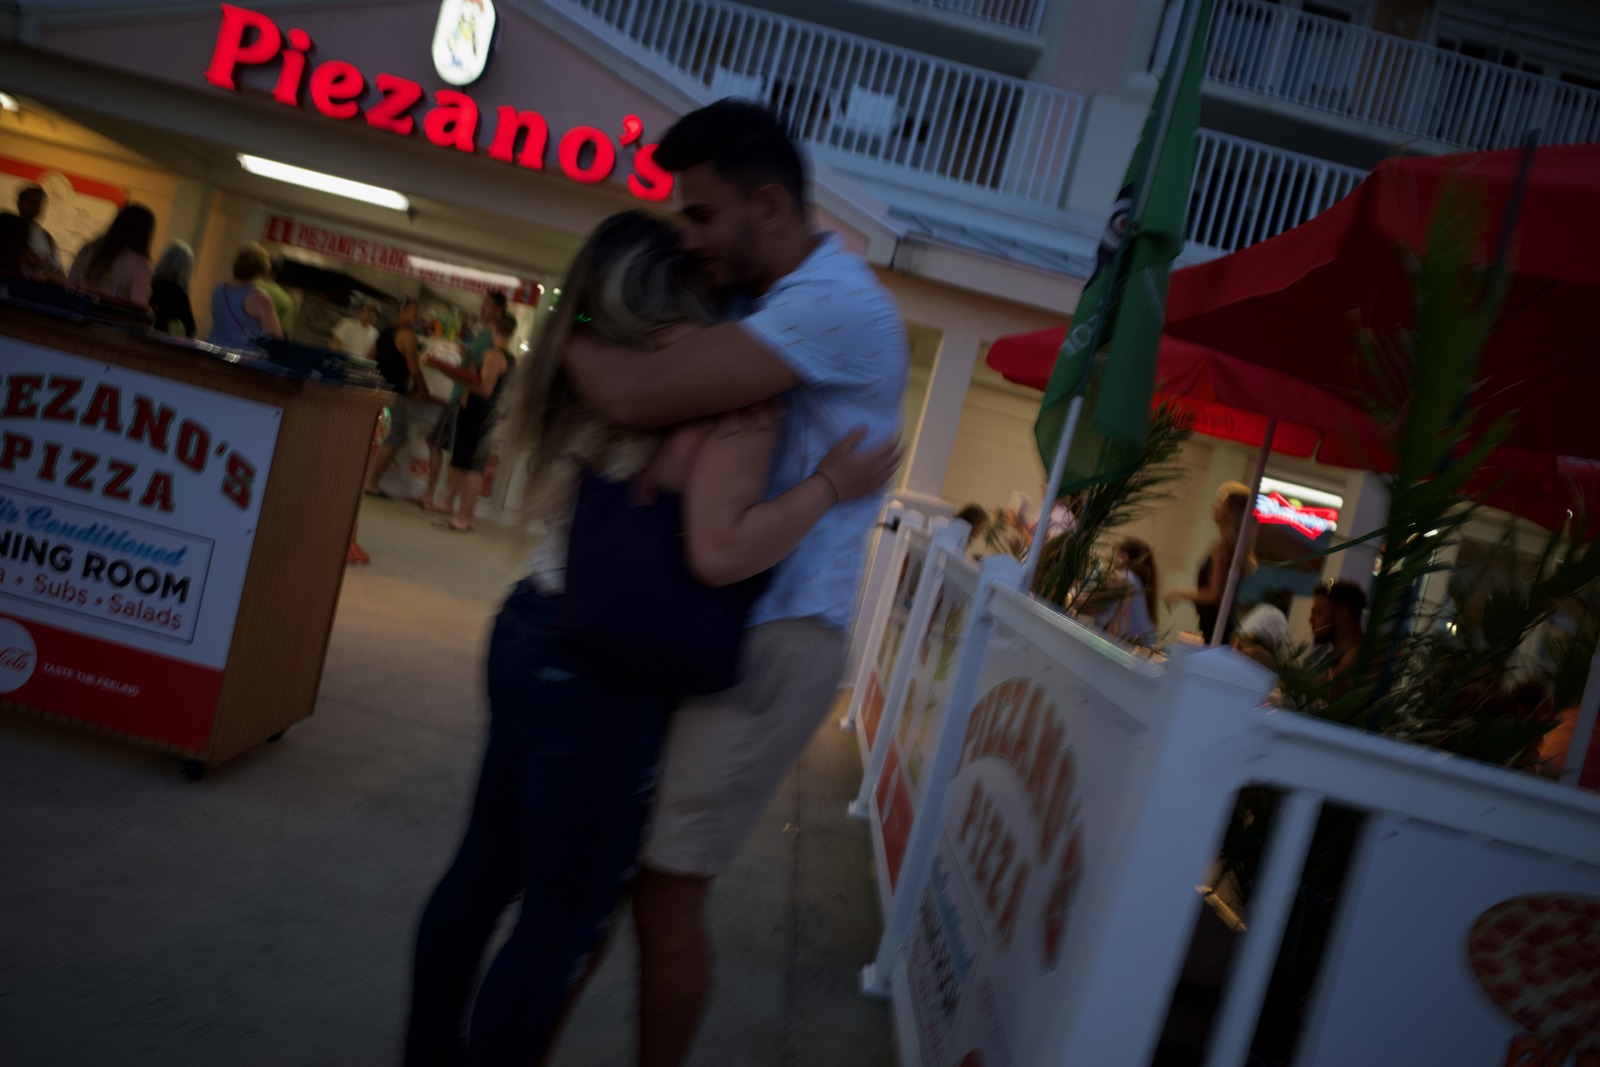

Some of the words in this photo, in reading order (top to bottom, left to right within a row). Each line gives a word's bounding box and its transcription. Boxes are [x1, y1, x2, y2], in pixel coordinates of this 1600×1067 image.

[204, 3, 674, 201] Piezano's
[0, 373, 257, 512] EZANO'S
[0, 430, 177, 513] PIZZA
[26, 504, 188, 566] Conditioned
[33, 574, 88, 606] Subs
[108, 593, 183, 631] Salads
[83, 550, 191, 604] ROOM
[42, 661, 75, 680] TASTE
[76, 670, 96, 686] THE
[96, 676, 141, 698] FEELING
[958, 775, 1034, 952] PIZZA
